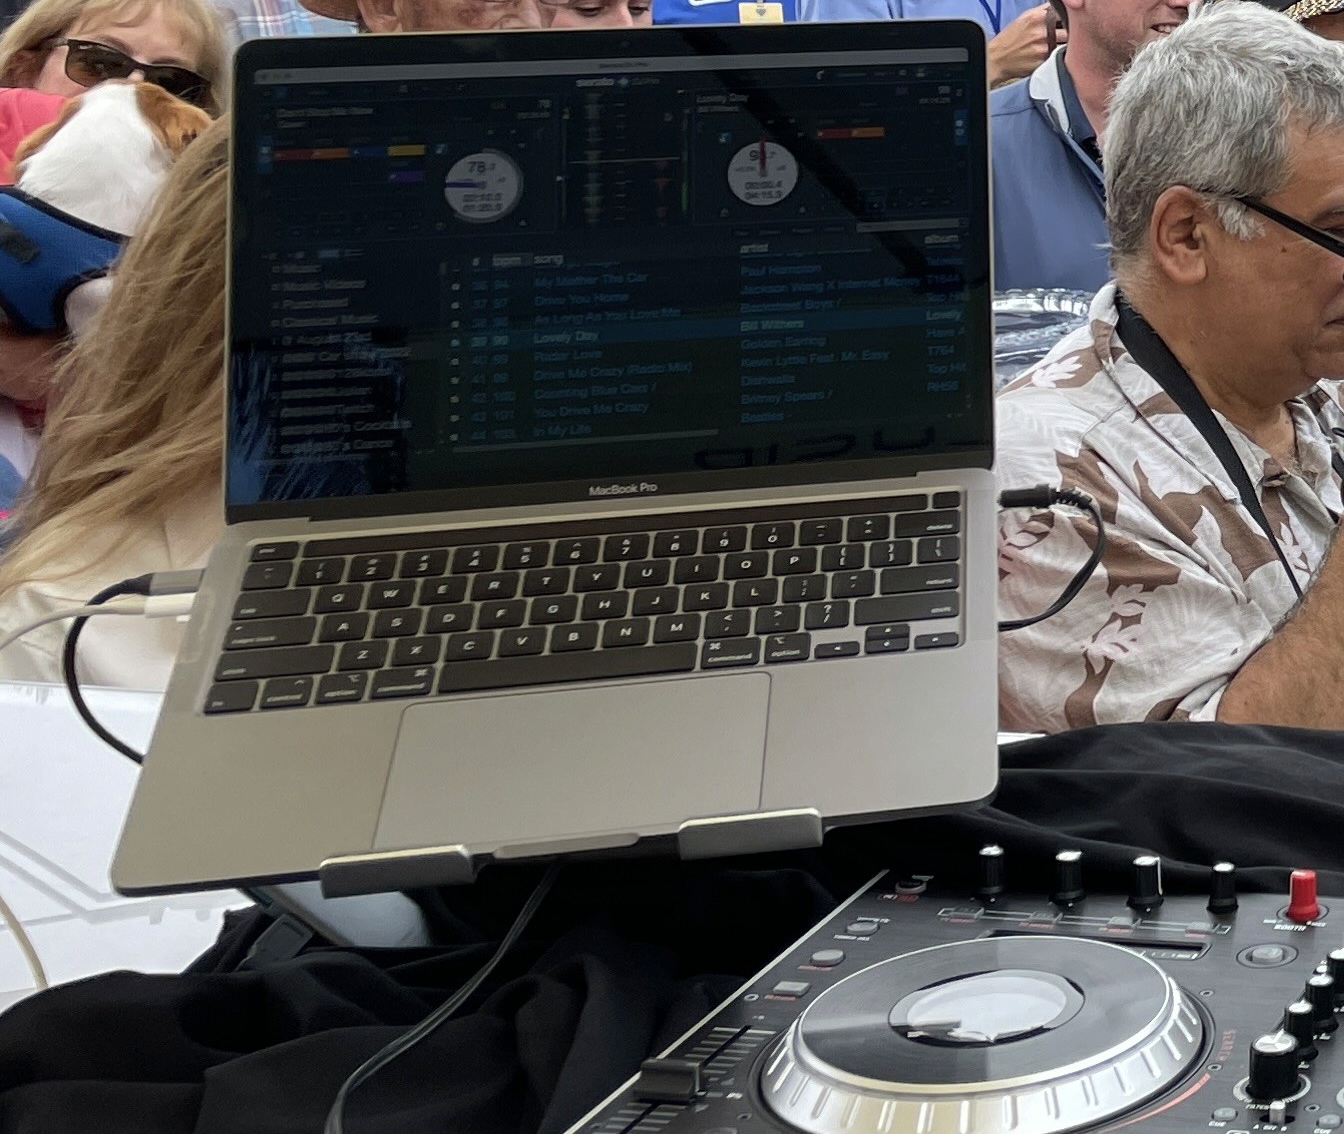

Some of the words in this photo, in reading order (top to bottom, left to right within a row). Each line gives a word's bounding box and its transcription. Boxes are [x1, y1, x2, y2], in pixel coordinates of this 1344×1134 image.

[533, 332, 572, 344] Lovely
[575, 330, 600, 342] Day
[589, 484, 637, 496] MacBook
[639, 482, 658, 493] Pro
[708, 652, 752, 663] command
[771, 649, 800, 657] option
